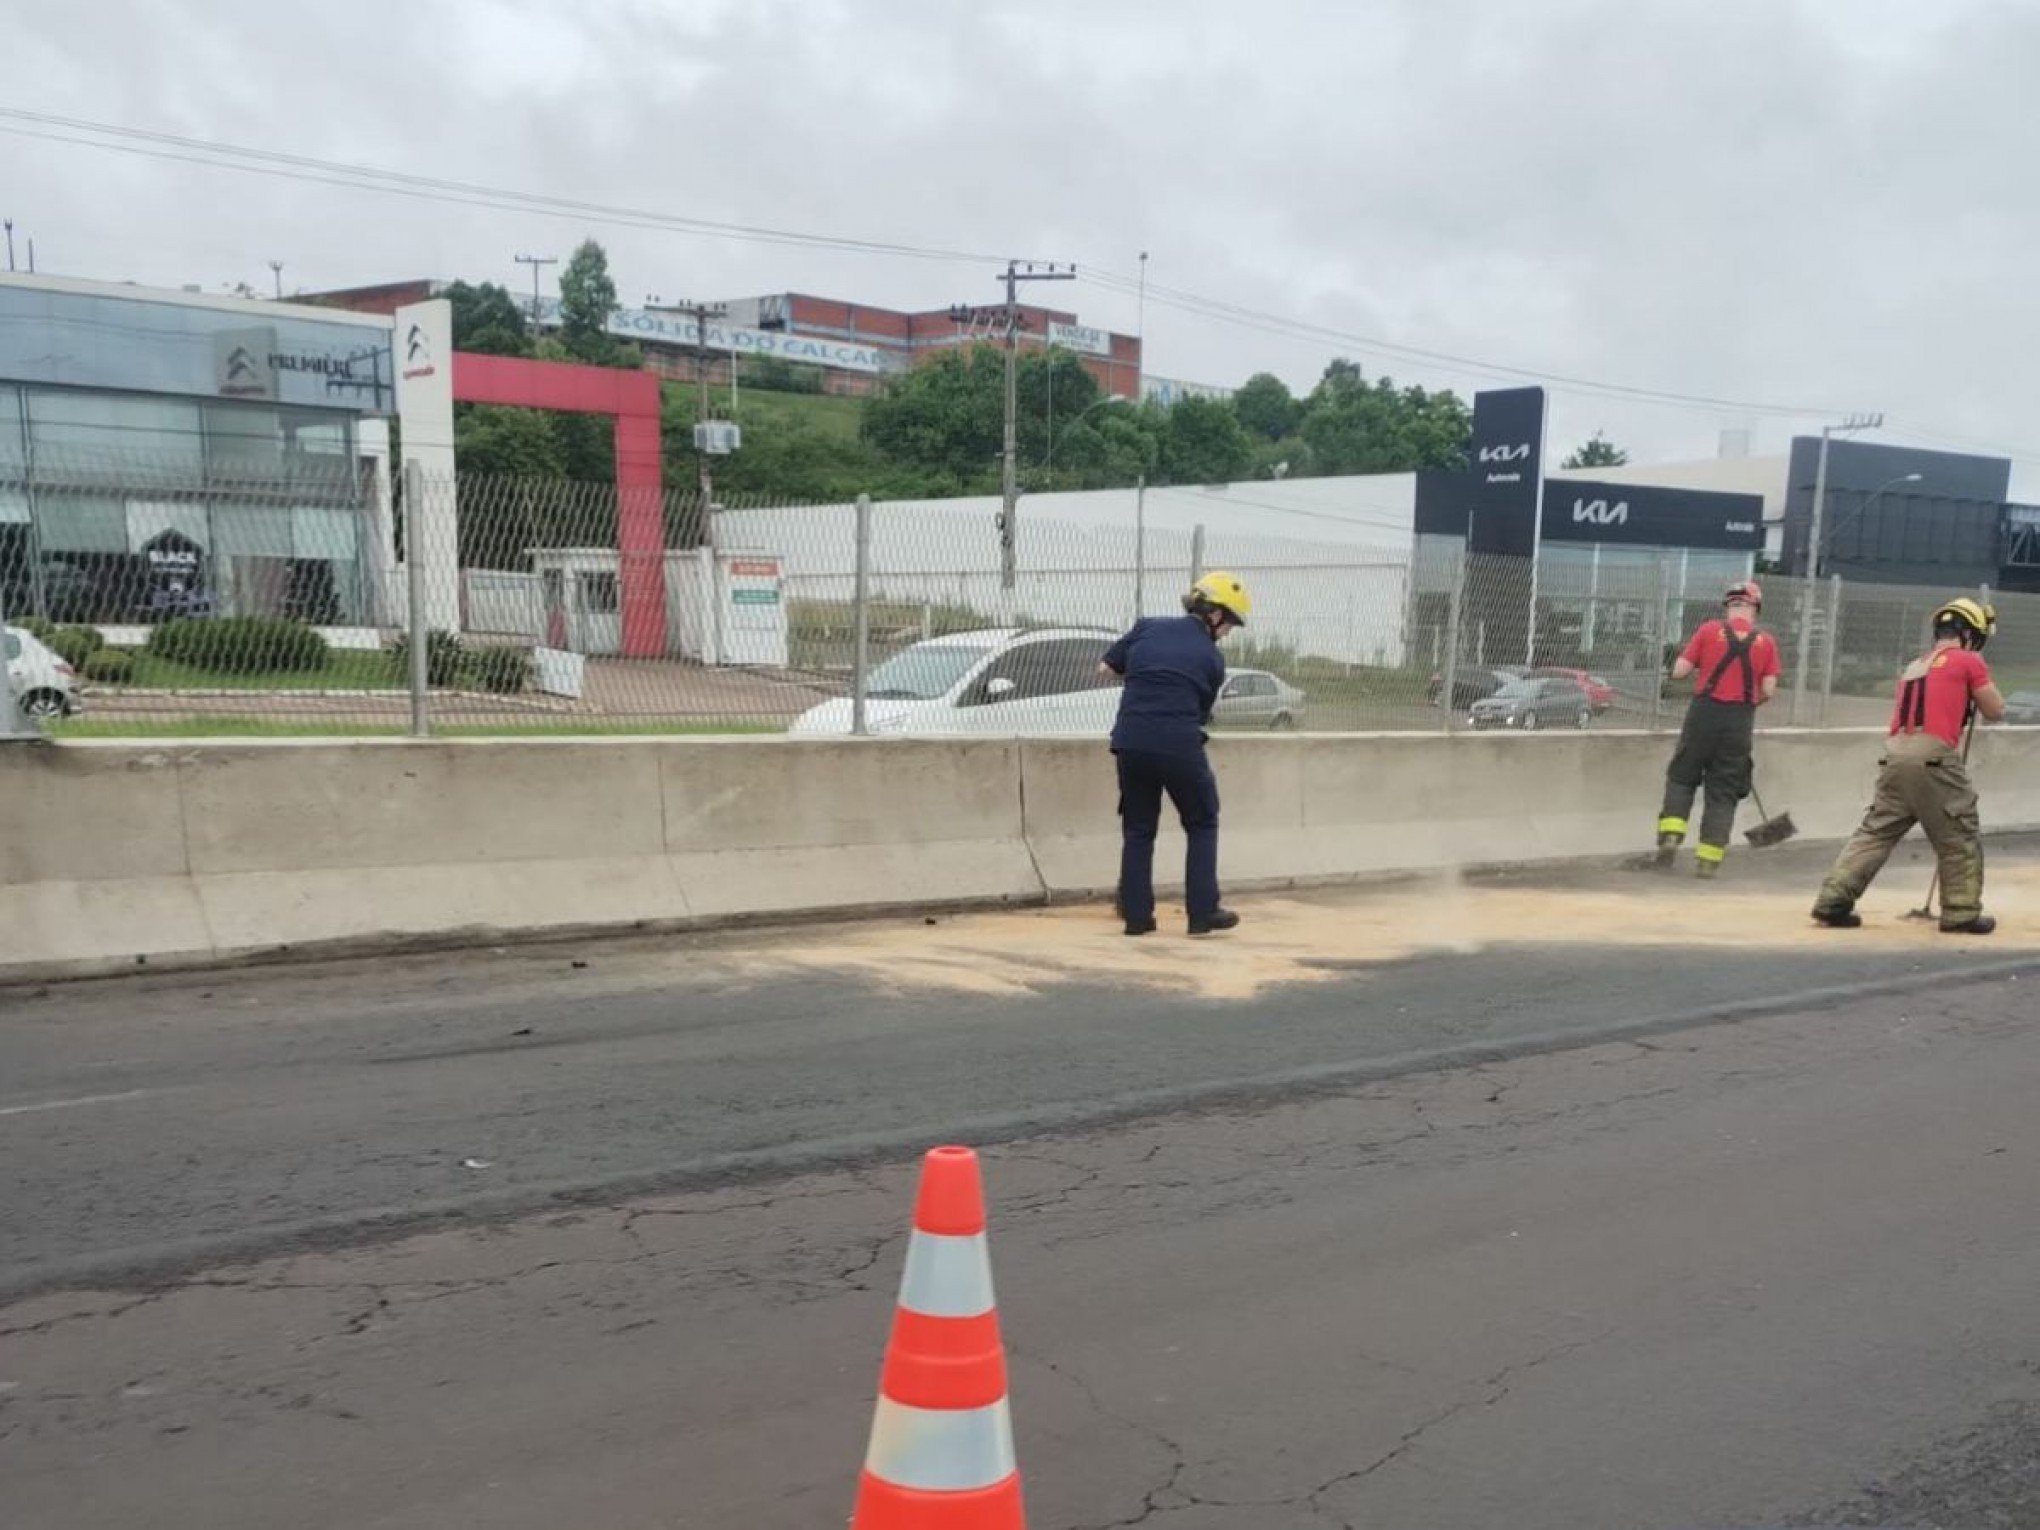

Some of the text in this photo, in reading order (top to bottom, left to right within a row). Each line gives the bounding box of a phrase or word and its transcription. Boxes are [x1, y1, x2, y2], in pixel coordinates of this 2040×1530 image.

[734, 331, 775, 350] DO
[1479, 443, 1530, 462] KIA
[1573, 498, 1628, 525] KIA
